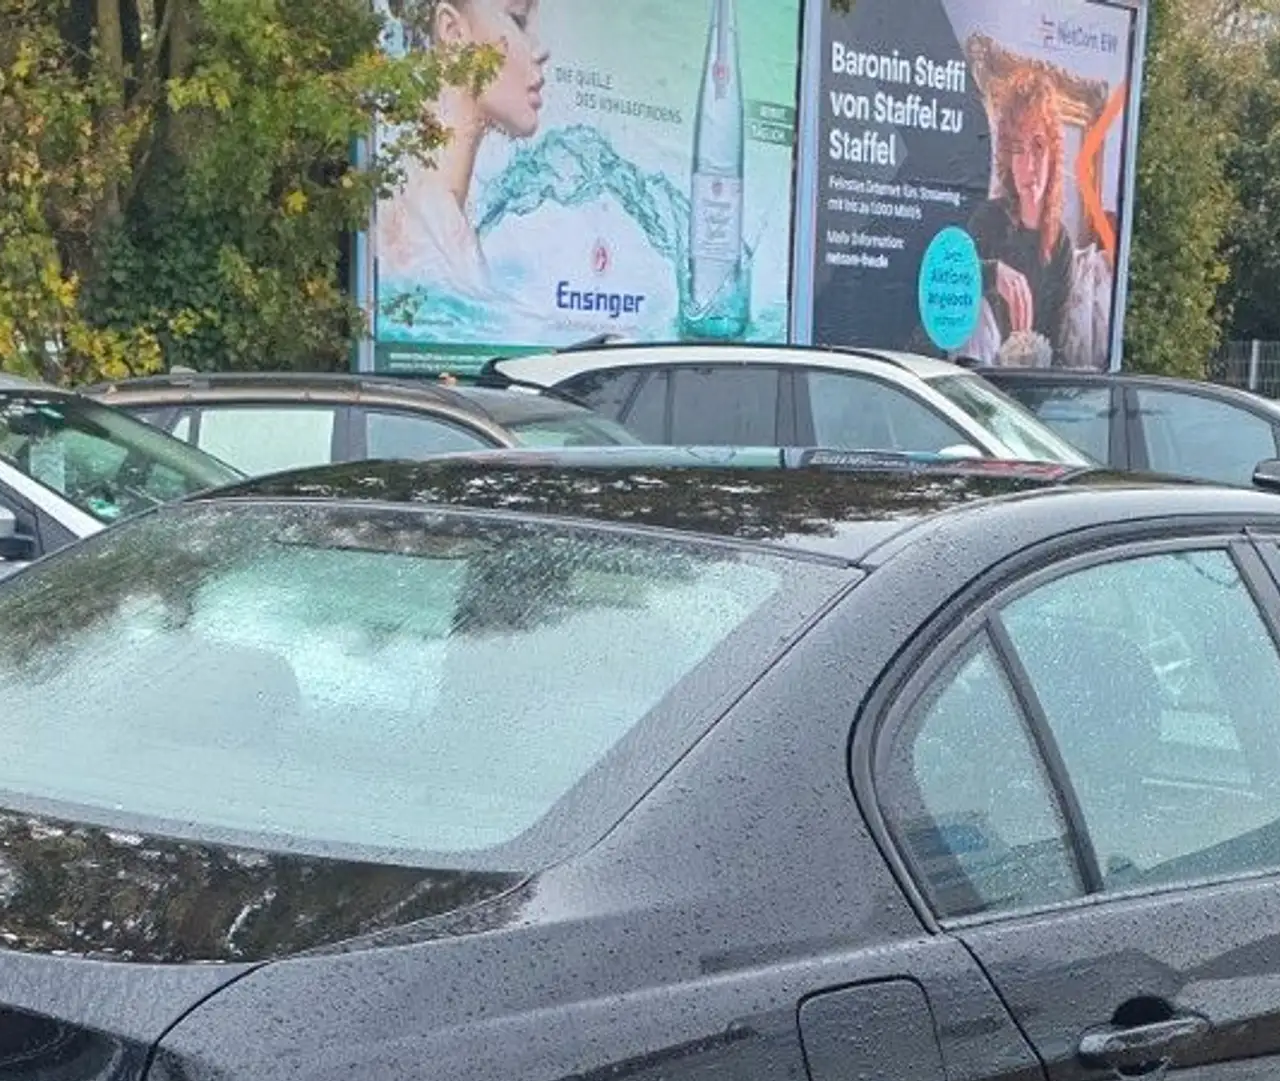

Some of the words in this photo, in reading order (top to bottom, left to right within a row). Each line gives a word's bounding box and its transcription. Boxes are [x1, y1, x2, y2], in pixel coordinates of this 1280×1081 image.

[832, 41, 910, 84] Baronin
[915, 55, 966, 92] Steffi
[830, 91, 869, 121] von
[874, 91, 937, 129] Staffel
[939, 108, 964, 133] zu
[829, 128, 896, 166] Staffel
